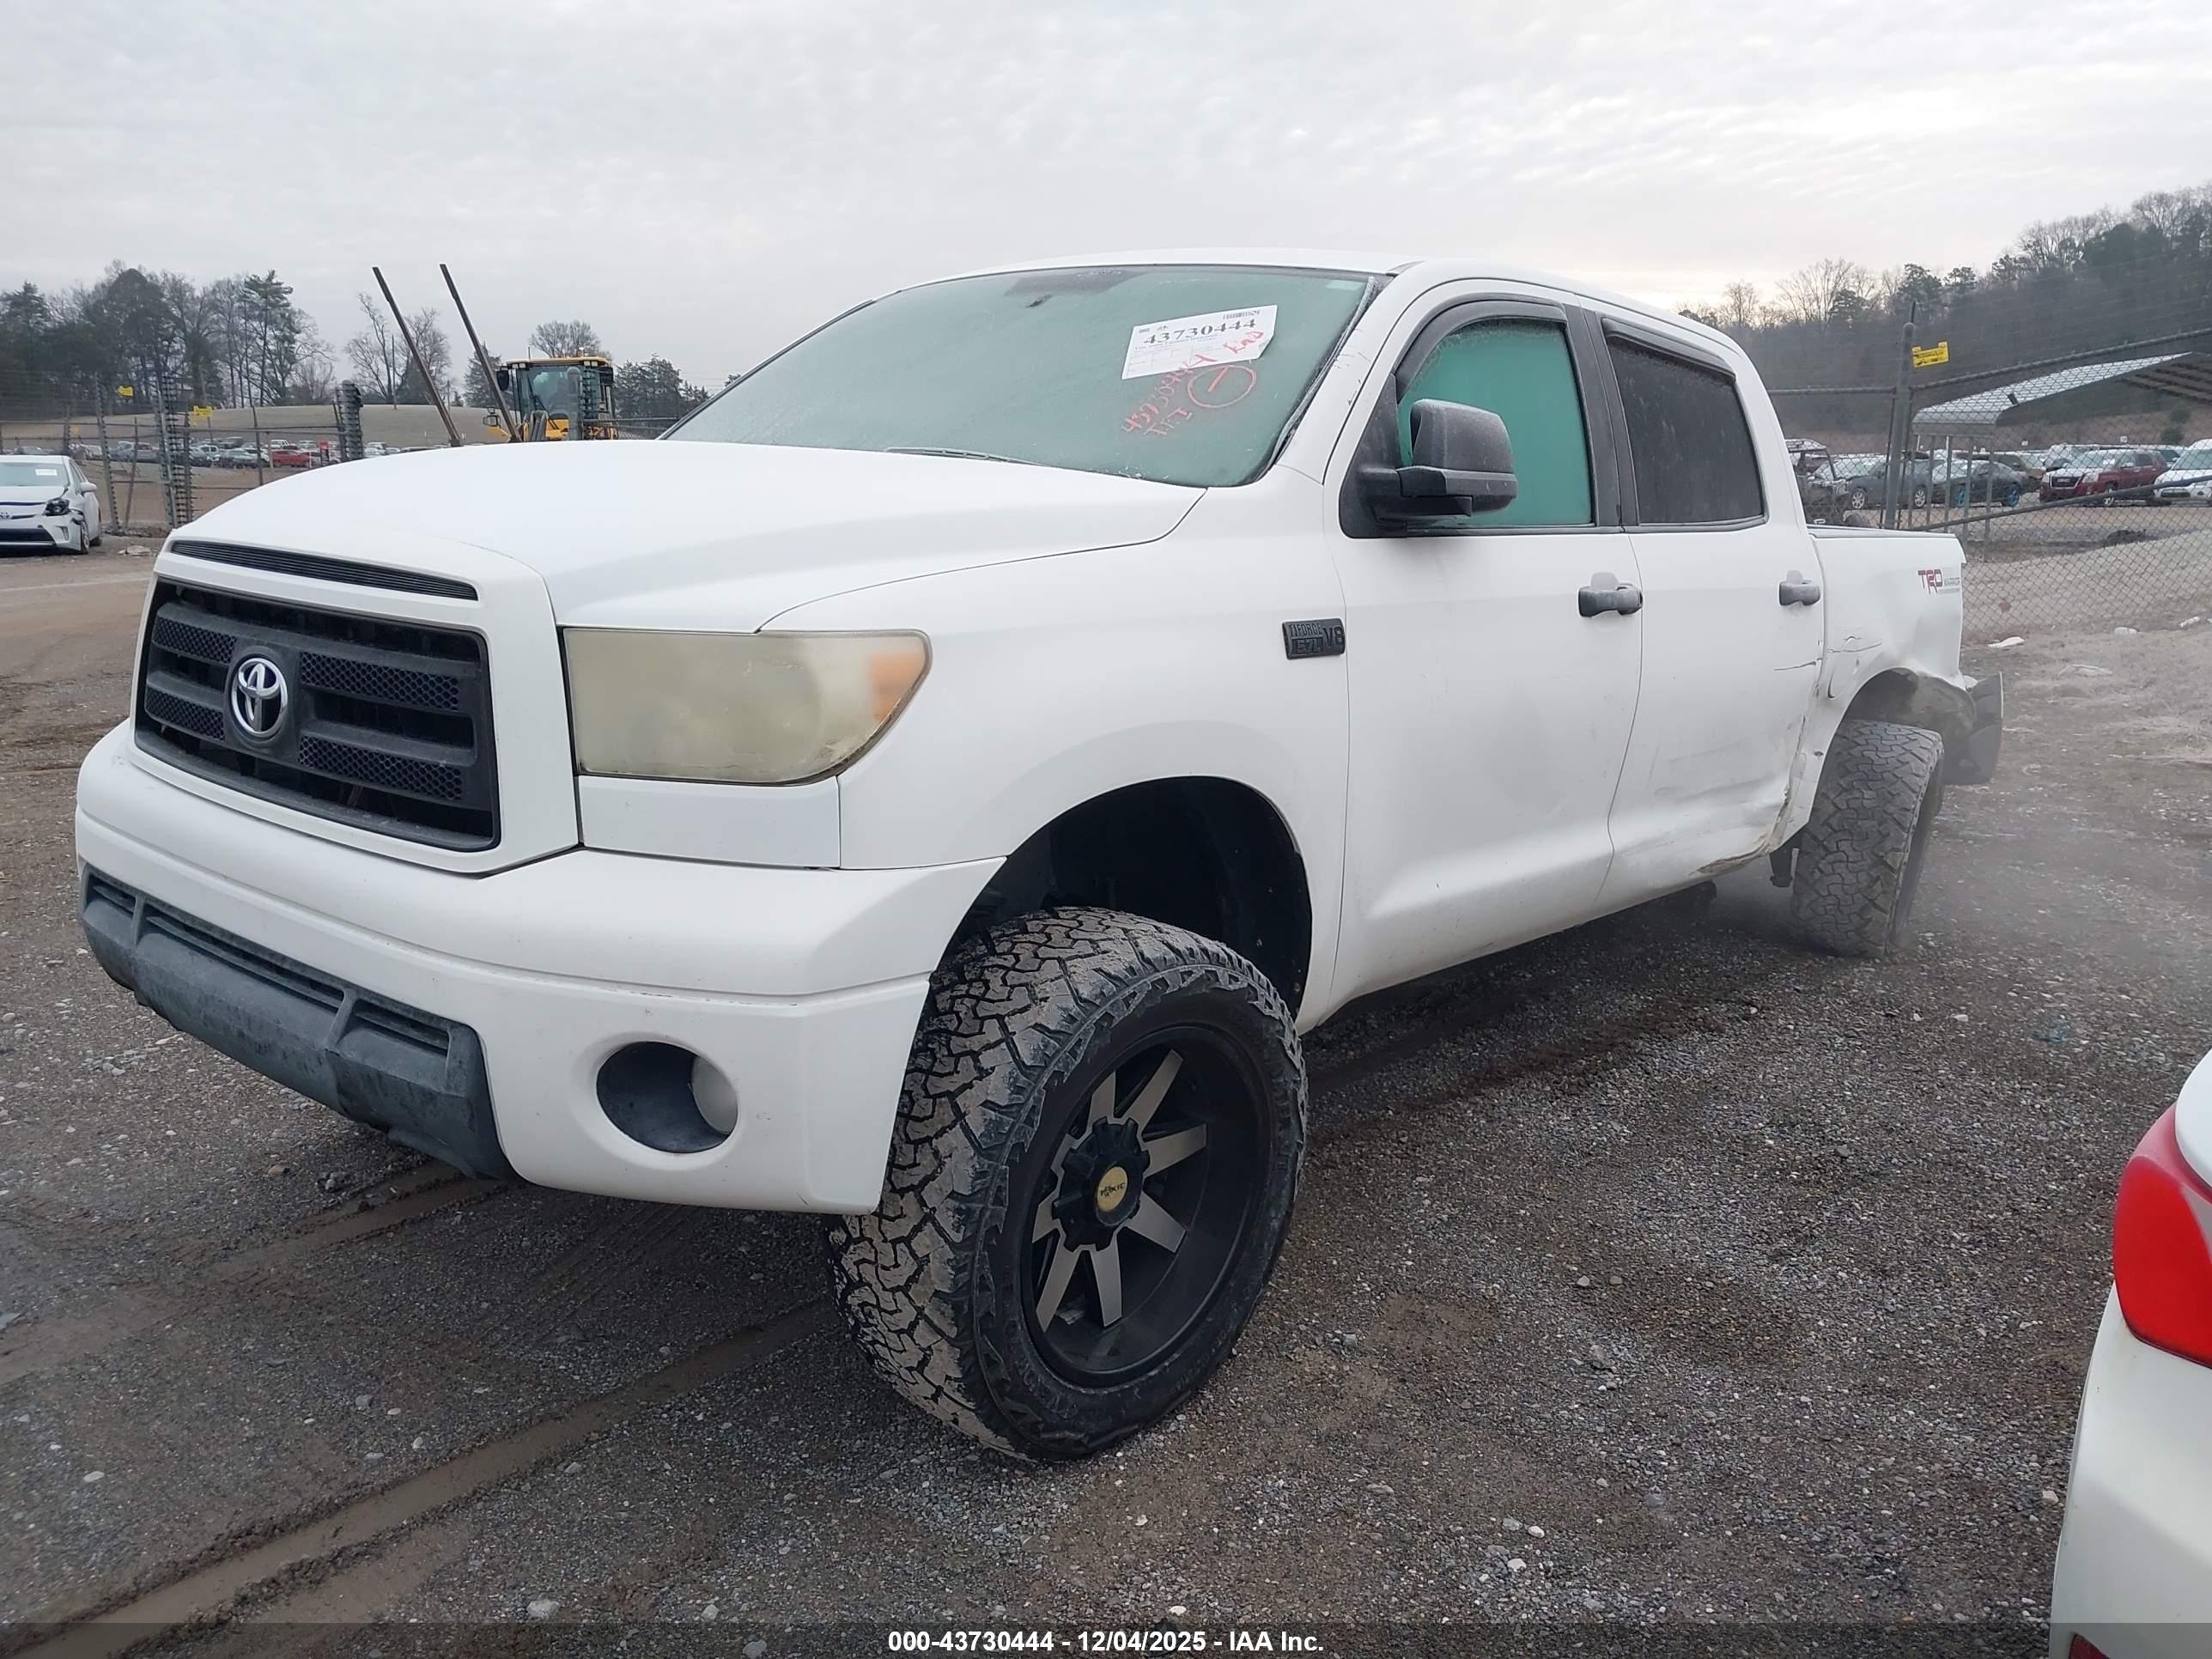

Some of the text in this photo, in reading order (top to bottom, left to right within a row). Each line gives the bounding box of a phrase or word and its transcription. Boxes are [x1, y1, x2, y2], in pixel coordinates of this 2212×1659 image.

[1143, 319, 1256, 344] 43730444
[1917, 568, 1943, 595] TRD
[1322, 626, 1345, 647] V8
